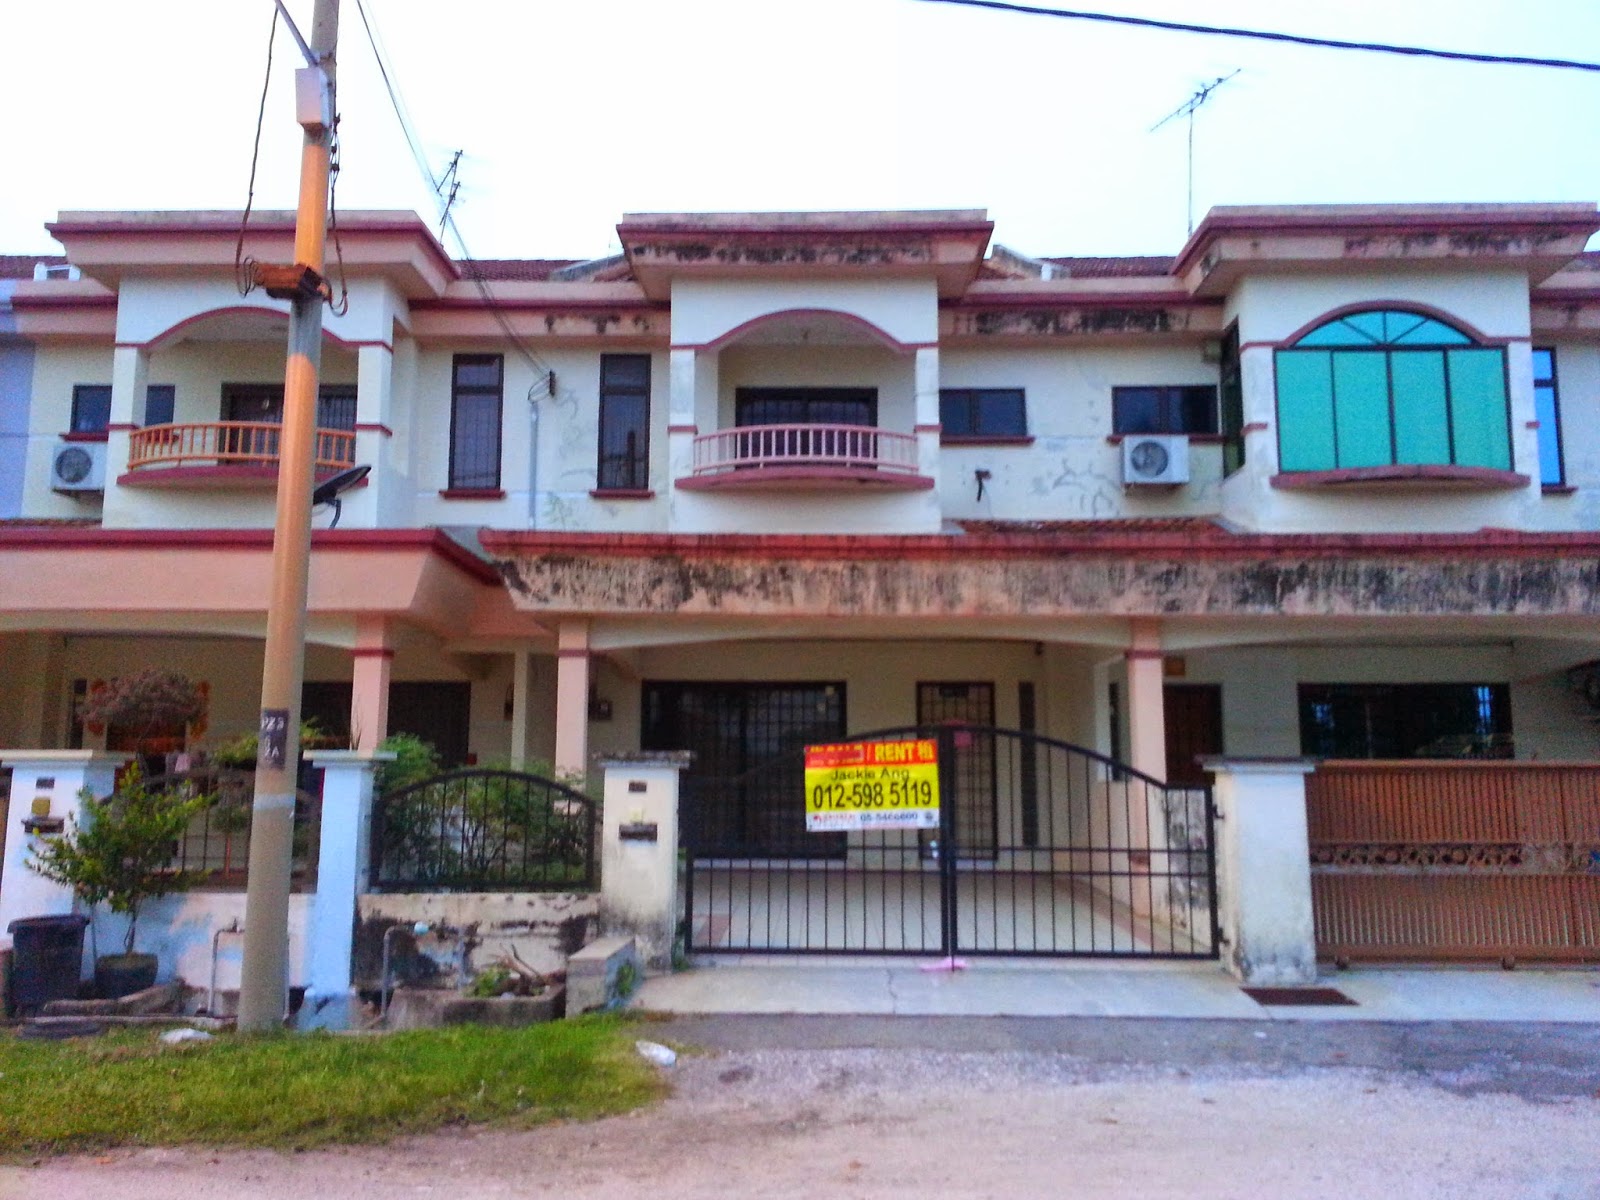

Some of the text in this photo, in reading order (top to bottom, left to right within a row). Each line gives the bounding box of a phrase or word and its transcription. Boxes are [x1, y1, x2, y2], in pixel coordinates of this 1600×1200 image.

[875, 741, 914, 762] RENT
[831, 767, 910, 782] Jackie Ang
[813, 780, 932, 809] 012-598 5119
